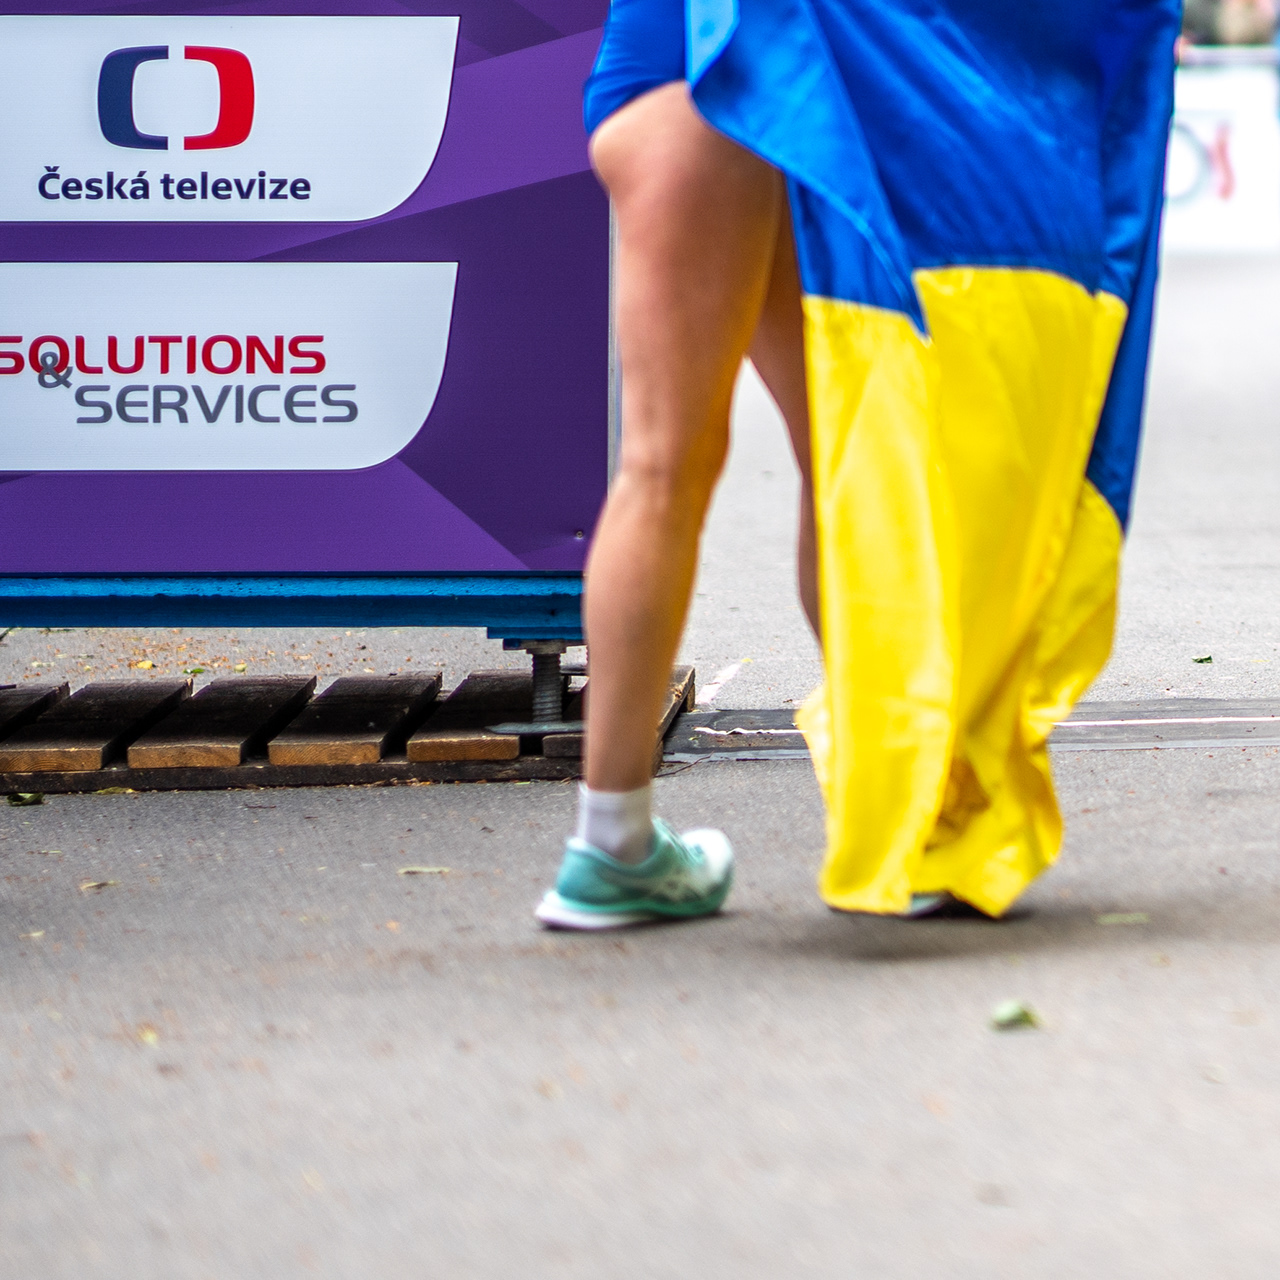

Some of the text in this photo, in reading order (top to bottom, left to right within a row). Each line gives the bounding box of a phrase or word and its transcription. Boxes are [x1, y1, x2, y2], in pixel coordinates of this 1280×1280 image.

[38, 166, 312, 200] Česká televize
[0, 334, 326, 375] SOLUTIONS
[37, 351, 359, 424] & SERVICES
